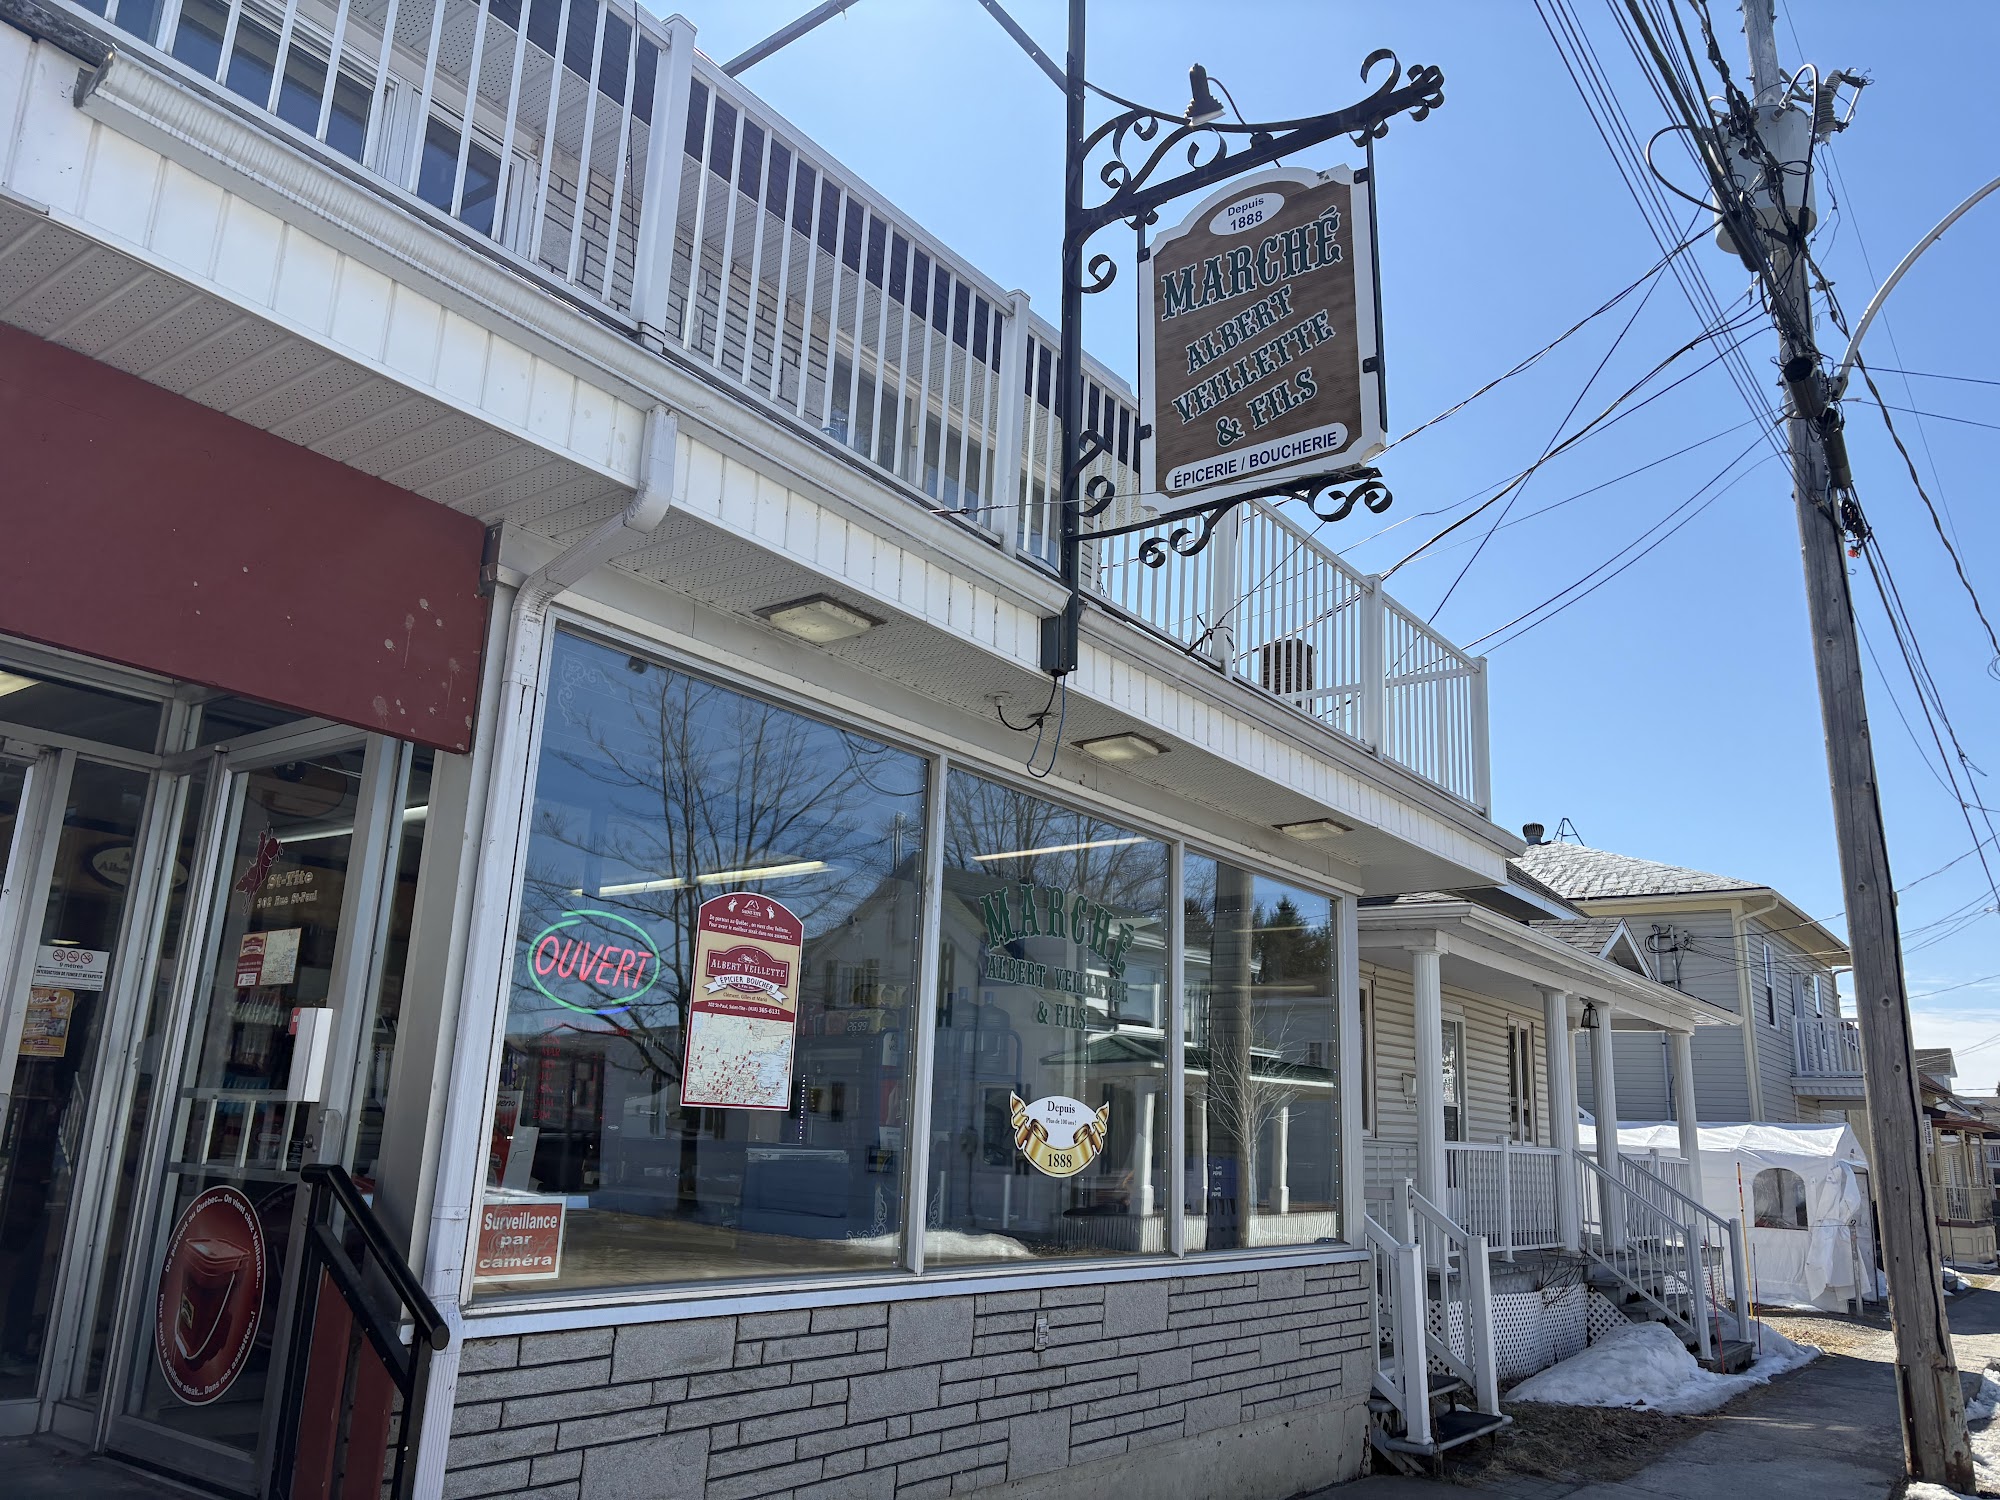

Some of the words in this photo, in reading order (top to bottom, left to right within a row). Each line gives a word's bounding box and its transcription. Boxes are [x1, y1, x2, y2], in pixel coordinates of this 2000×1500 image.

[1228, 197, 1264, 216] Depuis
[1230, 211, 1263, 231] 1888
[1162, 205, 1343, 321] MARCHÉ
[1186, 285, 1291, 375] ALBERT
[1173, 309, 1336, 425] VEILLETTE
[1216, 416, 1245, 447] &
[1247, 367, 1318, 429] FILS
[1173, 461, 1237, 489] ÉPICERIE
[1240, 458, 1246, 473] /
[1249, 432, 1337, 468] BOUCHERIE
[267, 870, 313, 889] St-Tite
[274, 895, 288, 907] Rue
[980, 883, 1135, 976] MARCHÉ
[535, 935, 654, 990] OUVERT
[710, 959, 741, 972] ALBERT
[745, 964, 785, 978] VEILLETTE
[986, 954, 1047, 988] ALBERT
[746, 977, 774, 992] BOUCHER
[759, 1007, 780, 1015] 365-6131
[1037, 1001, 1048, 1025] &
[1055, 1003, 1087, 1031] FILS
[1047, 1100, 1076, 1116] Depuis
[1048, 1153, 1073, 1168] 1888
[484, 1212, 557, 1231] Surveillance
[165, 1257, 172, 1273] De
[171, 1220, 188, 1257] partout
[188, 1212, 196, 1223] au
[223, 1193, 232, 1204] On
[232, 1196, 246, 1215] vient
[244, 1213, 254, 1234] chez
[500, 1235, 533, 1249] par
[479, 1254, 552, 1269] caméra
[158, 1321, 167, 1348] avoir
[162, 1347, 168, 1359] le
[165, 1359, 183, 1388] meilleur
[219, 1369, 232, 1385] nos
[204, 1383, 220, 1395] Dans
